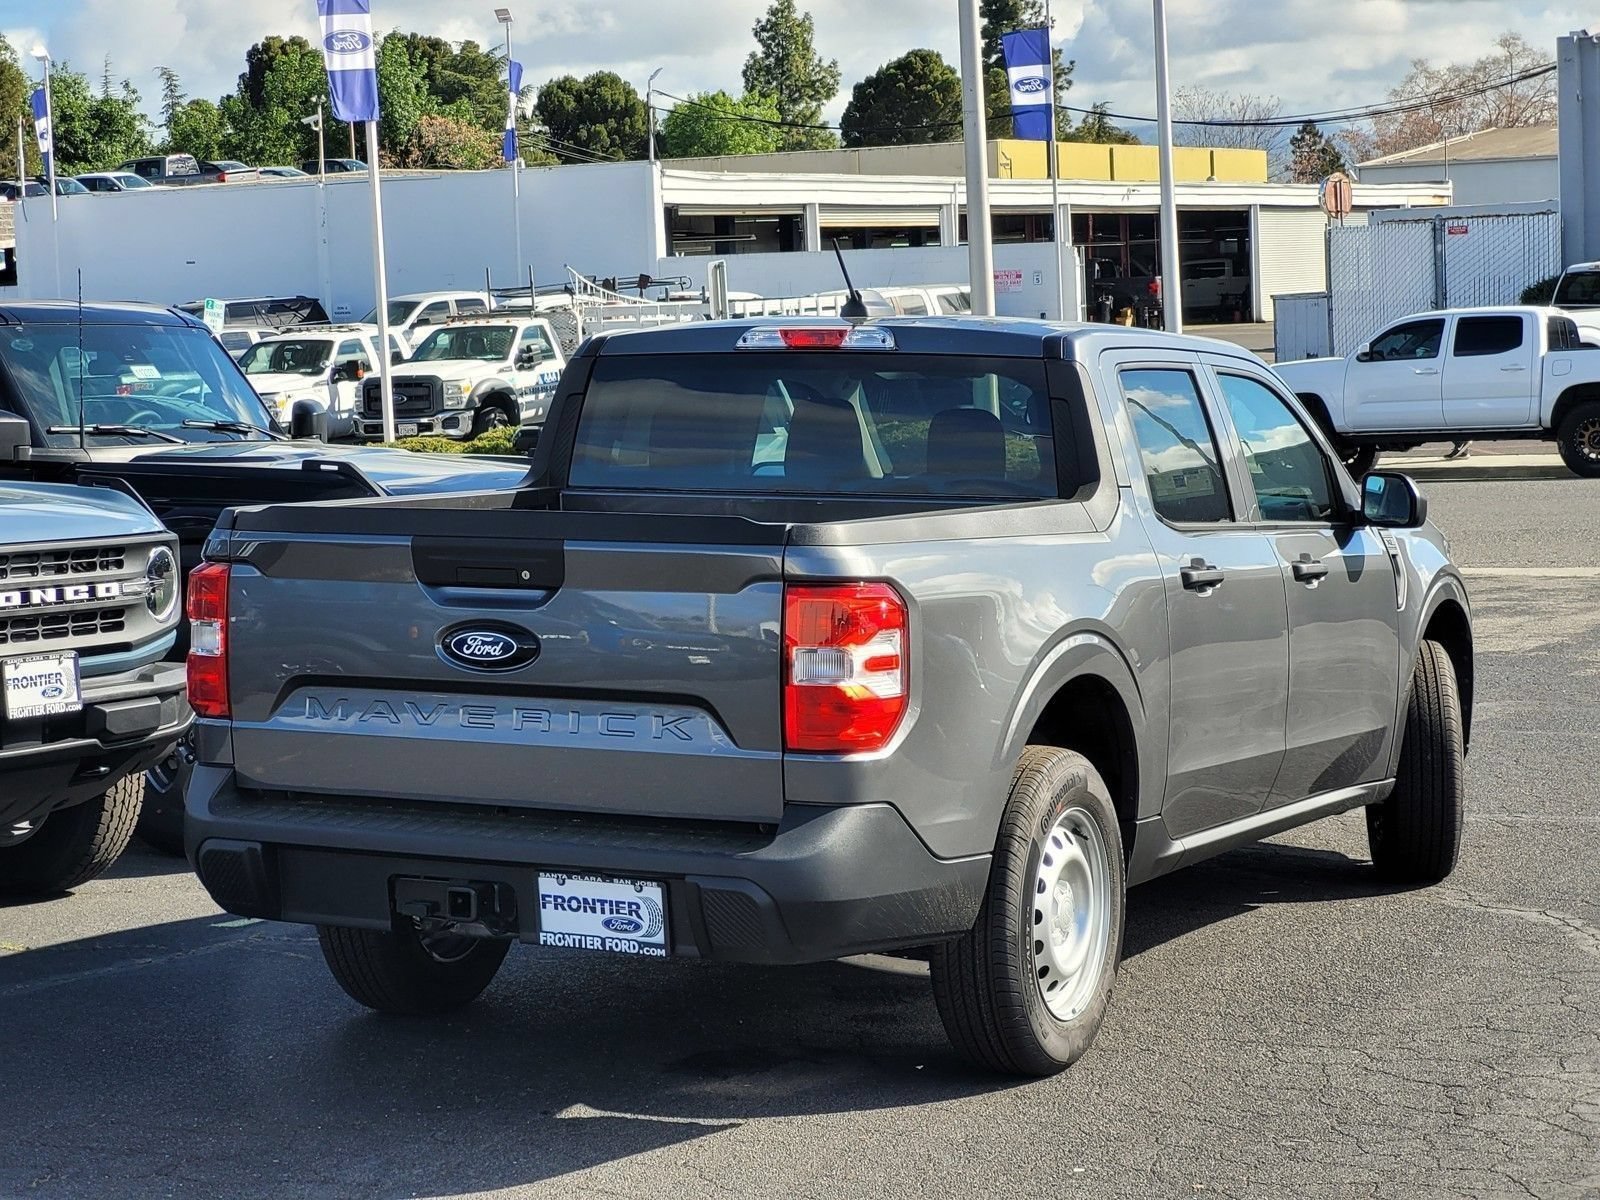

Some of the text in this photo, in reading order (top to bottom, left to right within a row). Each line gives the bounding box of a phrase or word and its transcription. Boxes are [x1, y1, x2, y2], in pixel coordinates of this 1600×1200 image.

[463, 635, 503, 656] Ford
[6, 672, 65, 690] FRONTIER
[9, 705, 46, 719] FRONTIER
[305, 696, 694, 742] MAVERICK
[539, 872, 568, 880] SANTA
[572, 874, 602, 883] CLARA
[634, 880, 658, 888] JOSE
[541, 893, 645, 923] FRONTIER
[609, 919, 636, 932] Ford
[540, 932, 603, 950] FRONTIER
